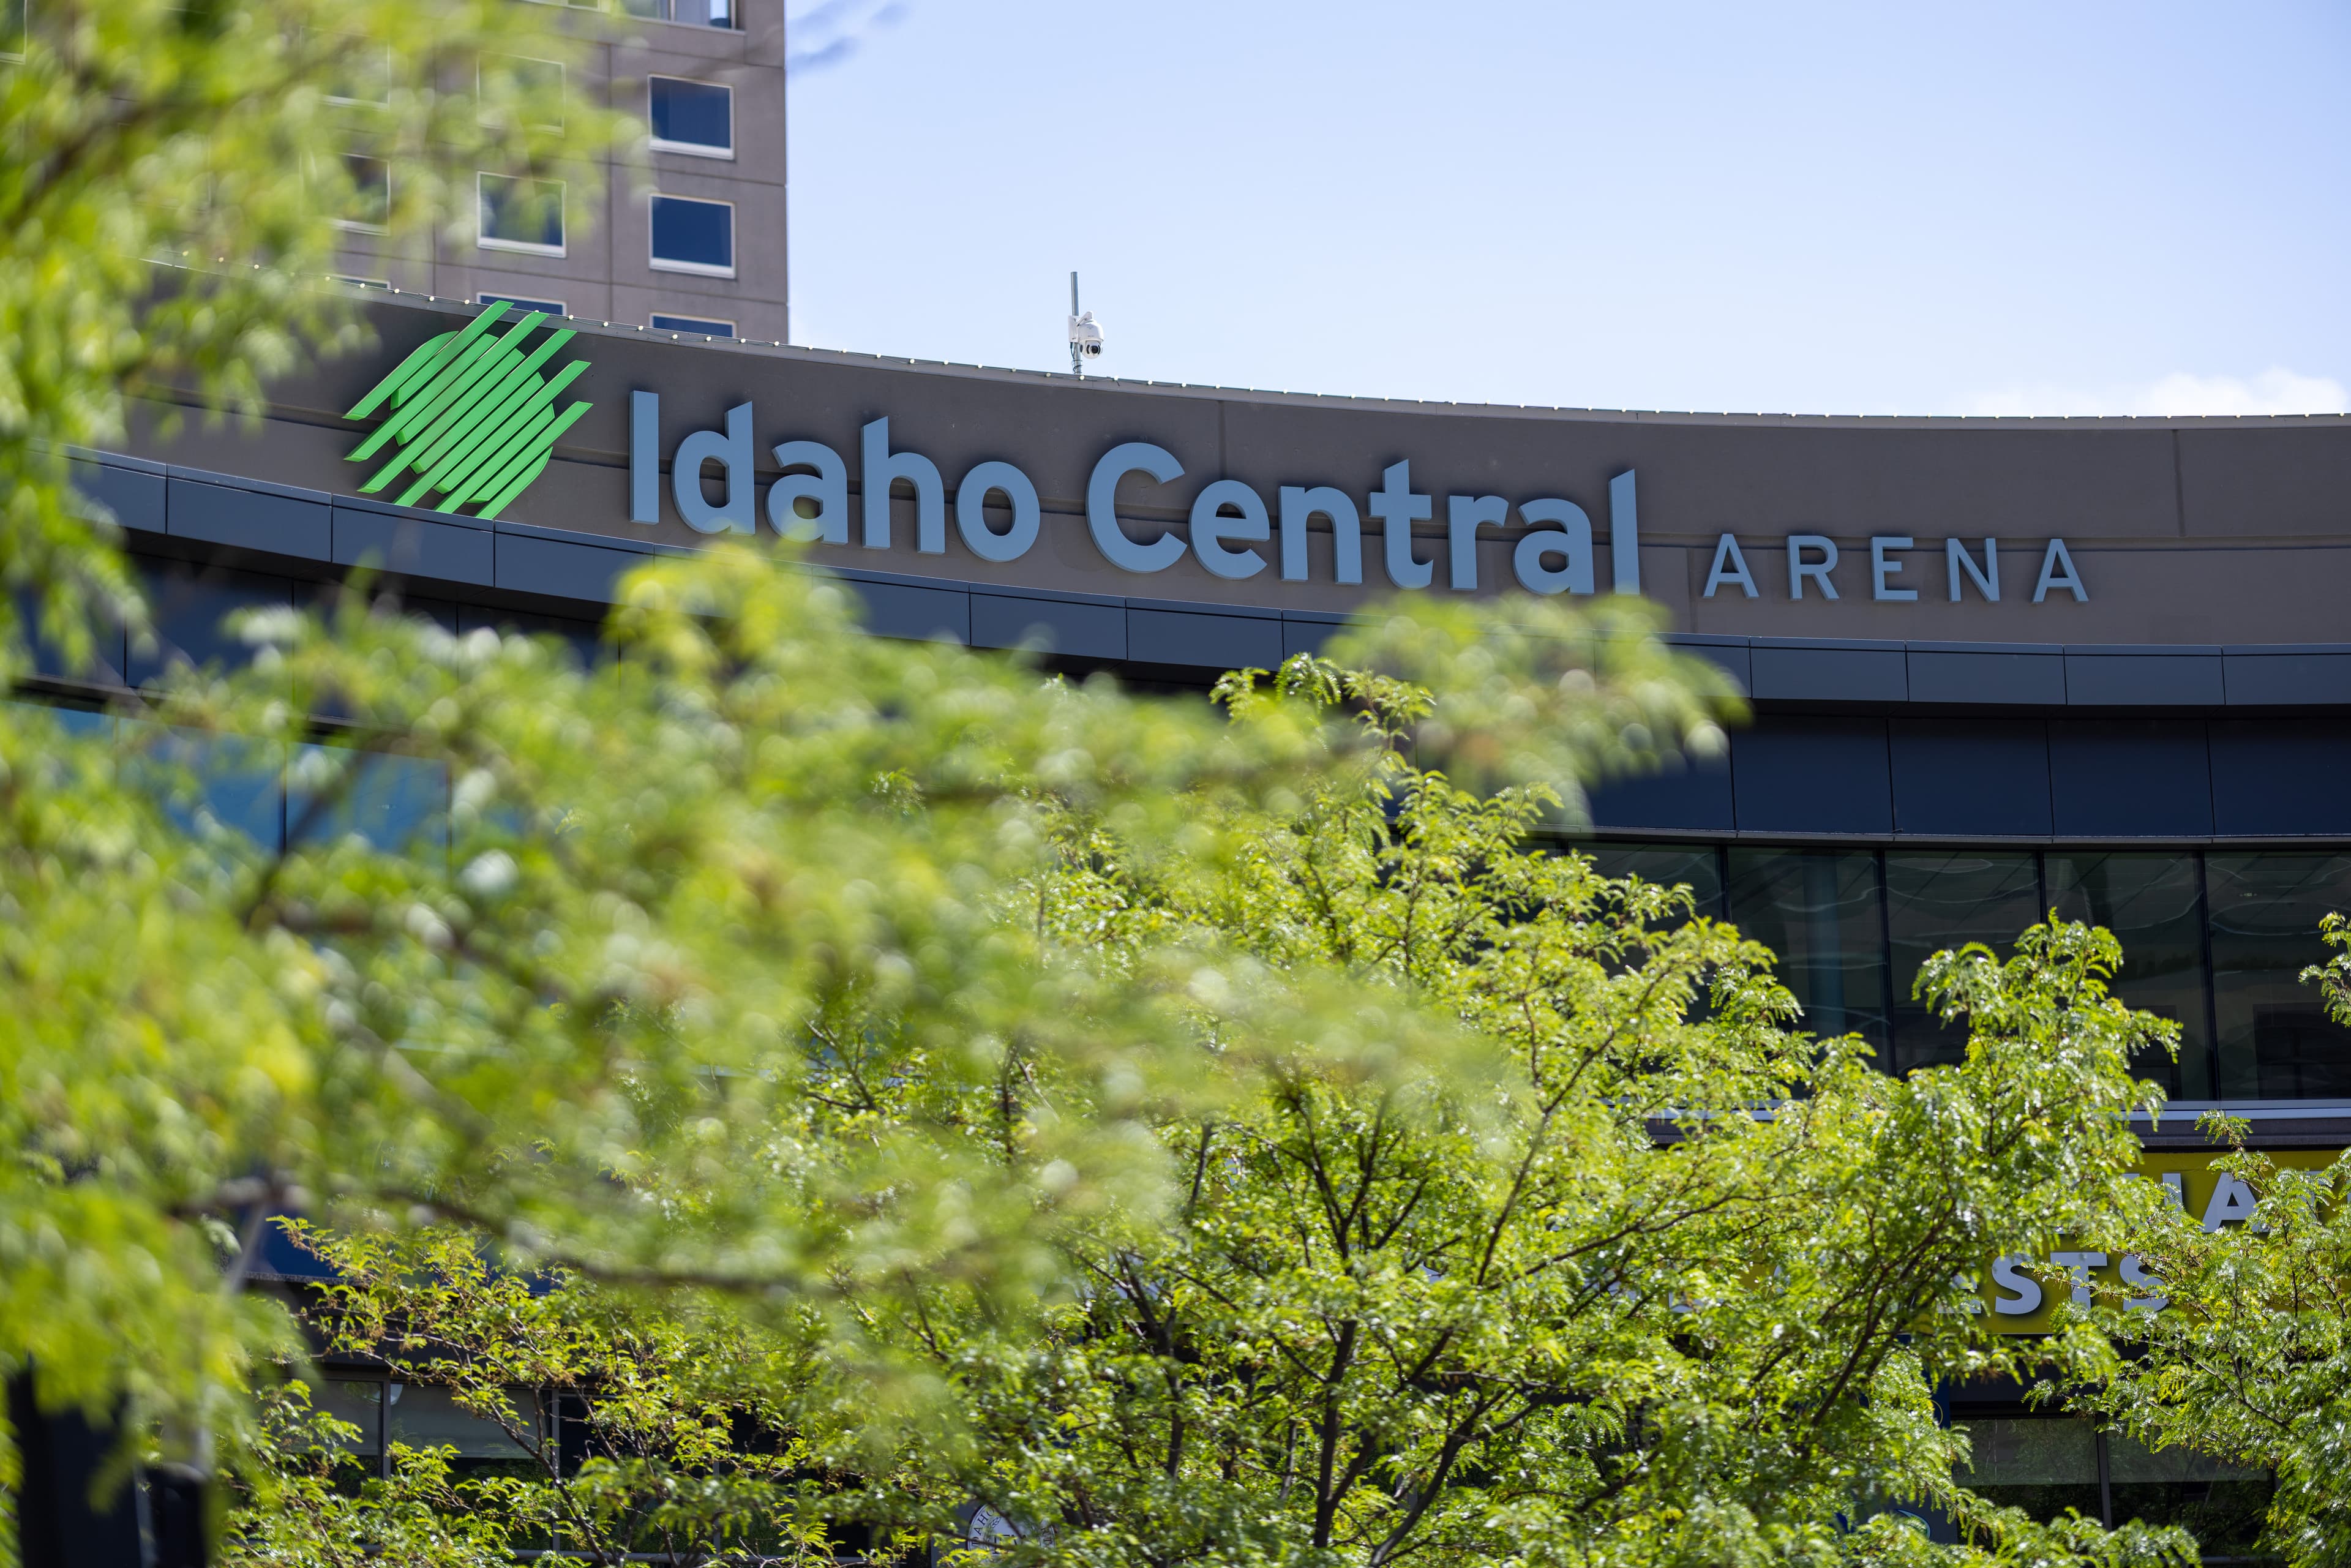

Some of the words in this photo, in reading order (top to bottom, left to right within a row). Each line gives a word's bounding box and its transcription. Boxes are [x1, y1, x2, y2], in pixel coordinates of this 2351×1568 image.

[629, 390, 1041, 562] Idaho
[1086, 442, 1641, 596] Central
[1703, 533, 2089, 603] ARENA
